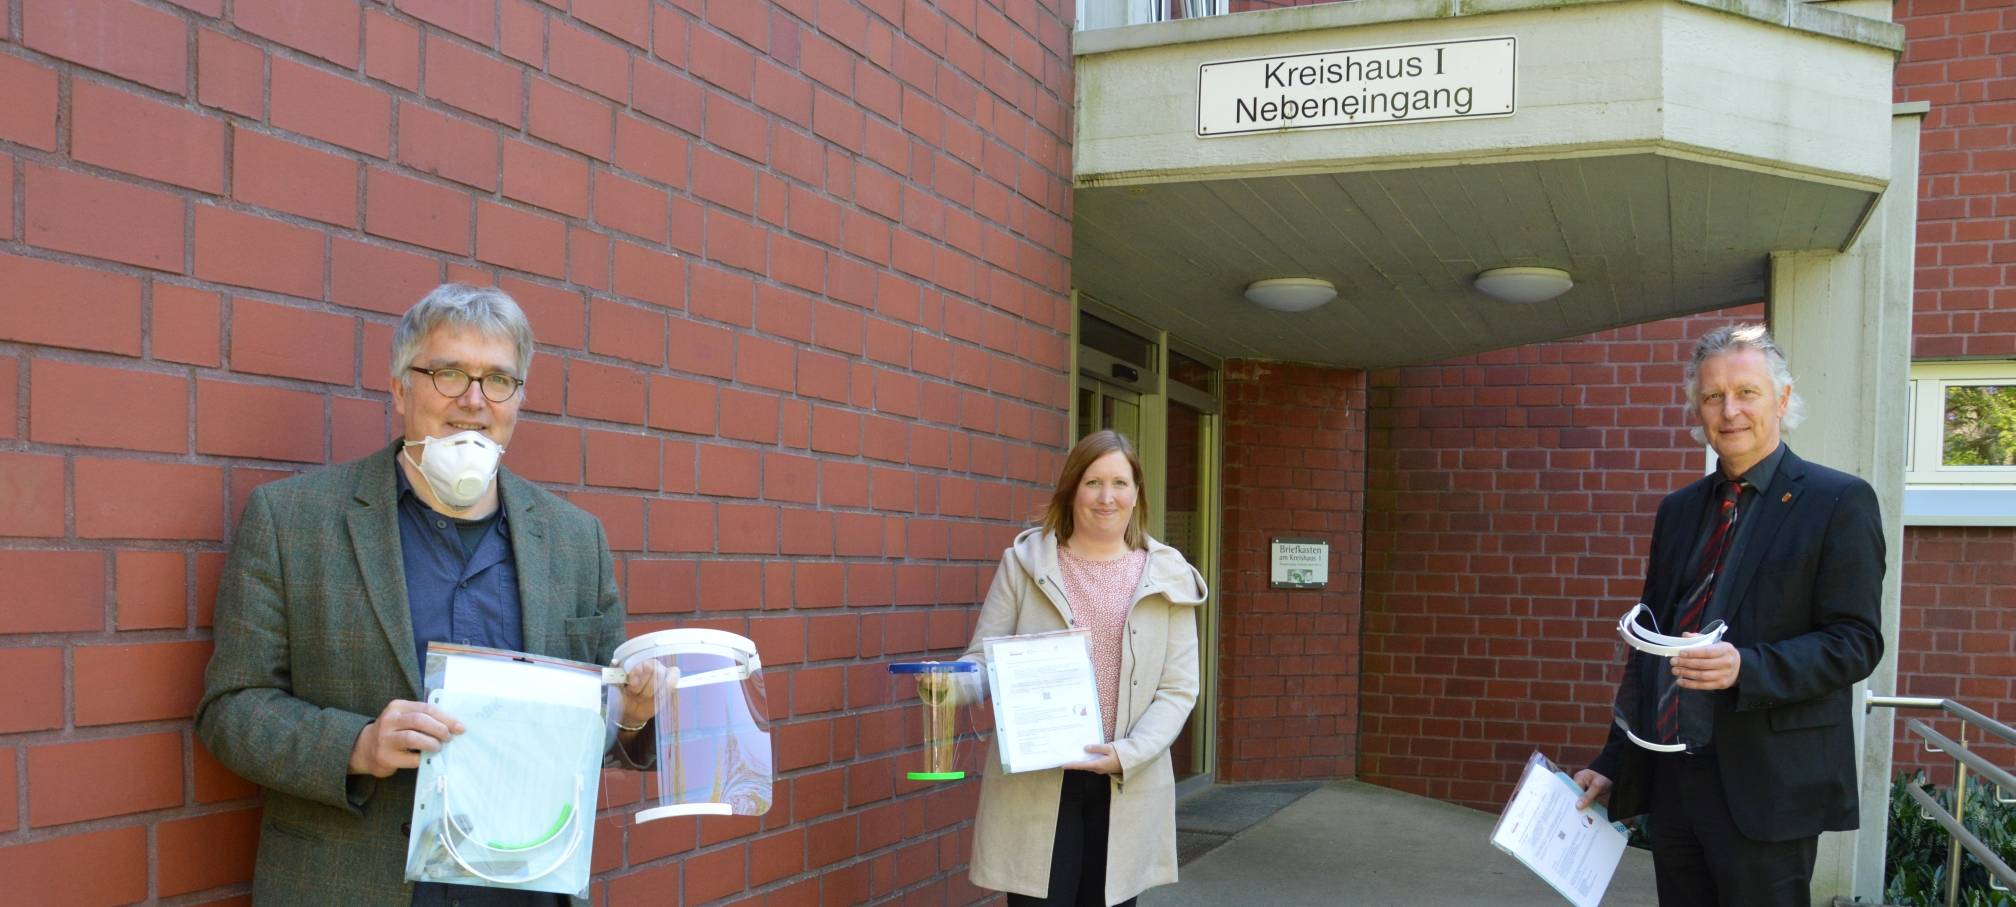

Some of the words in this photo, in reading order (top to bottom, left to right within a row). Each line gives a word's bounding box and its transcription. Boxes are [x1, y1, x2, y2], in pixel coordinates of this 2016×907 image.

[1265, 56, 1422, 88] Kreishaus
[1434, 48, 1447, 74] I
[1236, 86, 1473, 123] Nebeneingang
[1280, 545, 1321, 554] Briefkasten
